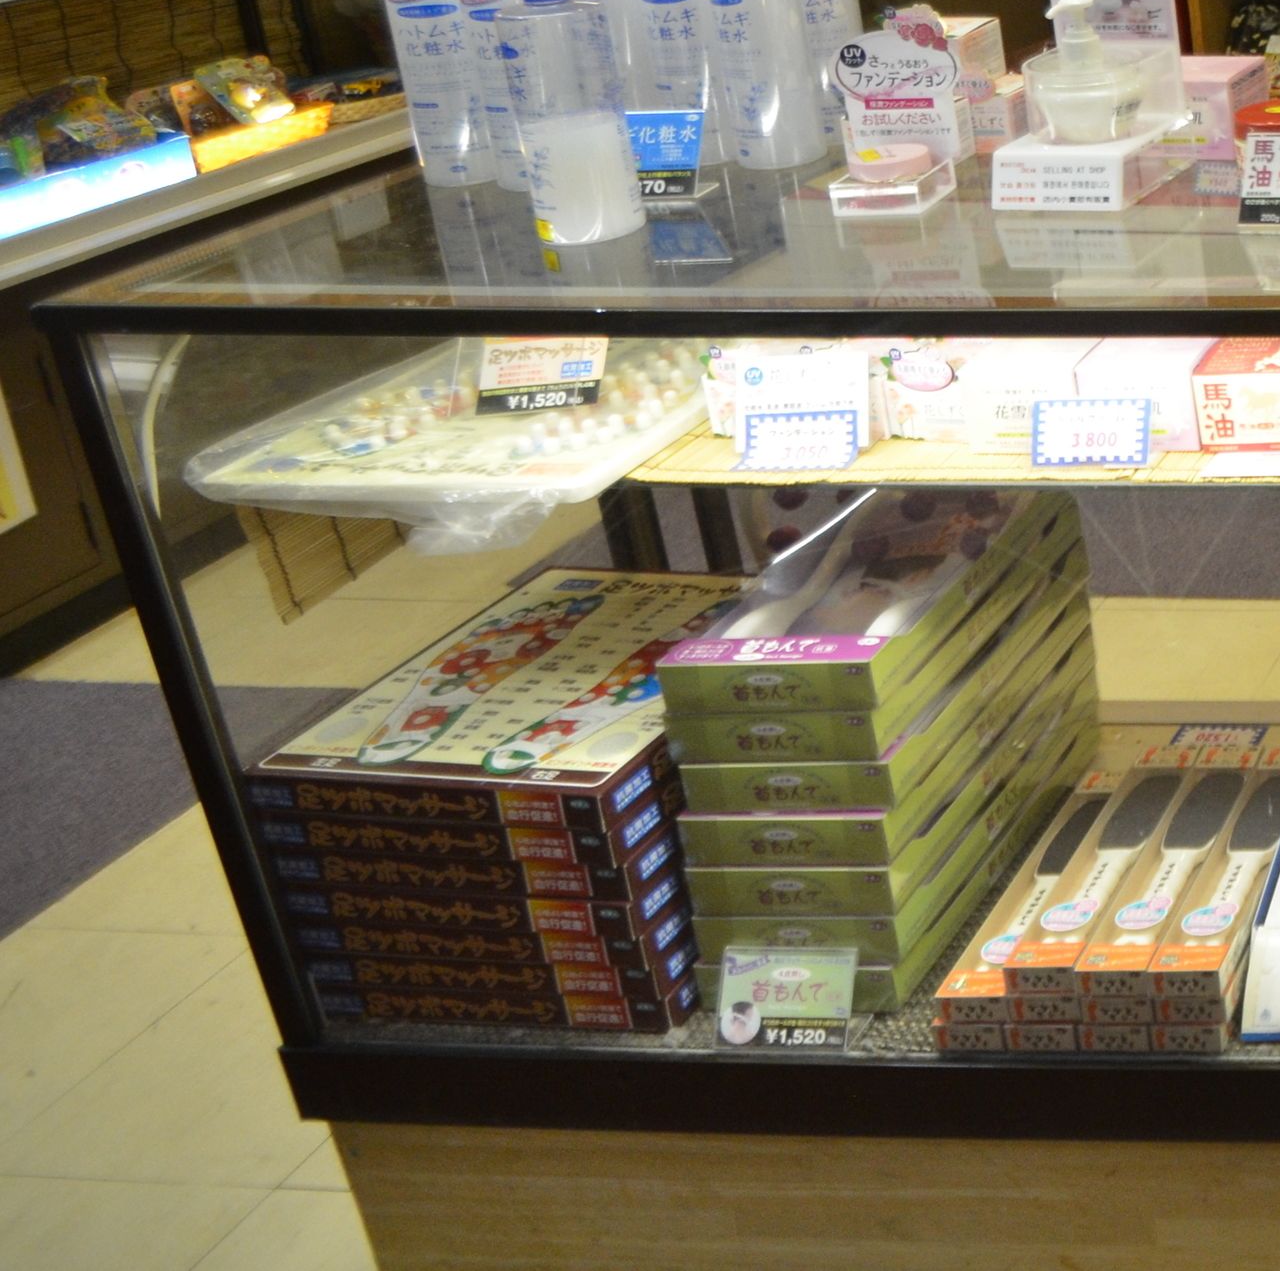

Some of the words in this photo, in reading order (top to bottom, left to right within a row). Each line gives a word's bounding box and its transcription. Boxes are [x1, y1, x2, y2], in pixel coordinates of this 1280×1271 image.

[404, 39, 465, 57] 化粧水
[843, 49, 861, 57] UV
[850, 72, 948, 88] ファンデーション
[862, 113, 941, 126] お試しください
[1251, 140, 1275, 189] 馬油
[508, 392, 567, 409] ¥1,520
[1202, 382, 1233, 440] 馬油
[752, 981, 828, 1002] 首もんで
[766, 1029, 826, 1045] ¥1,520
